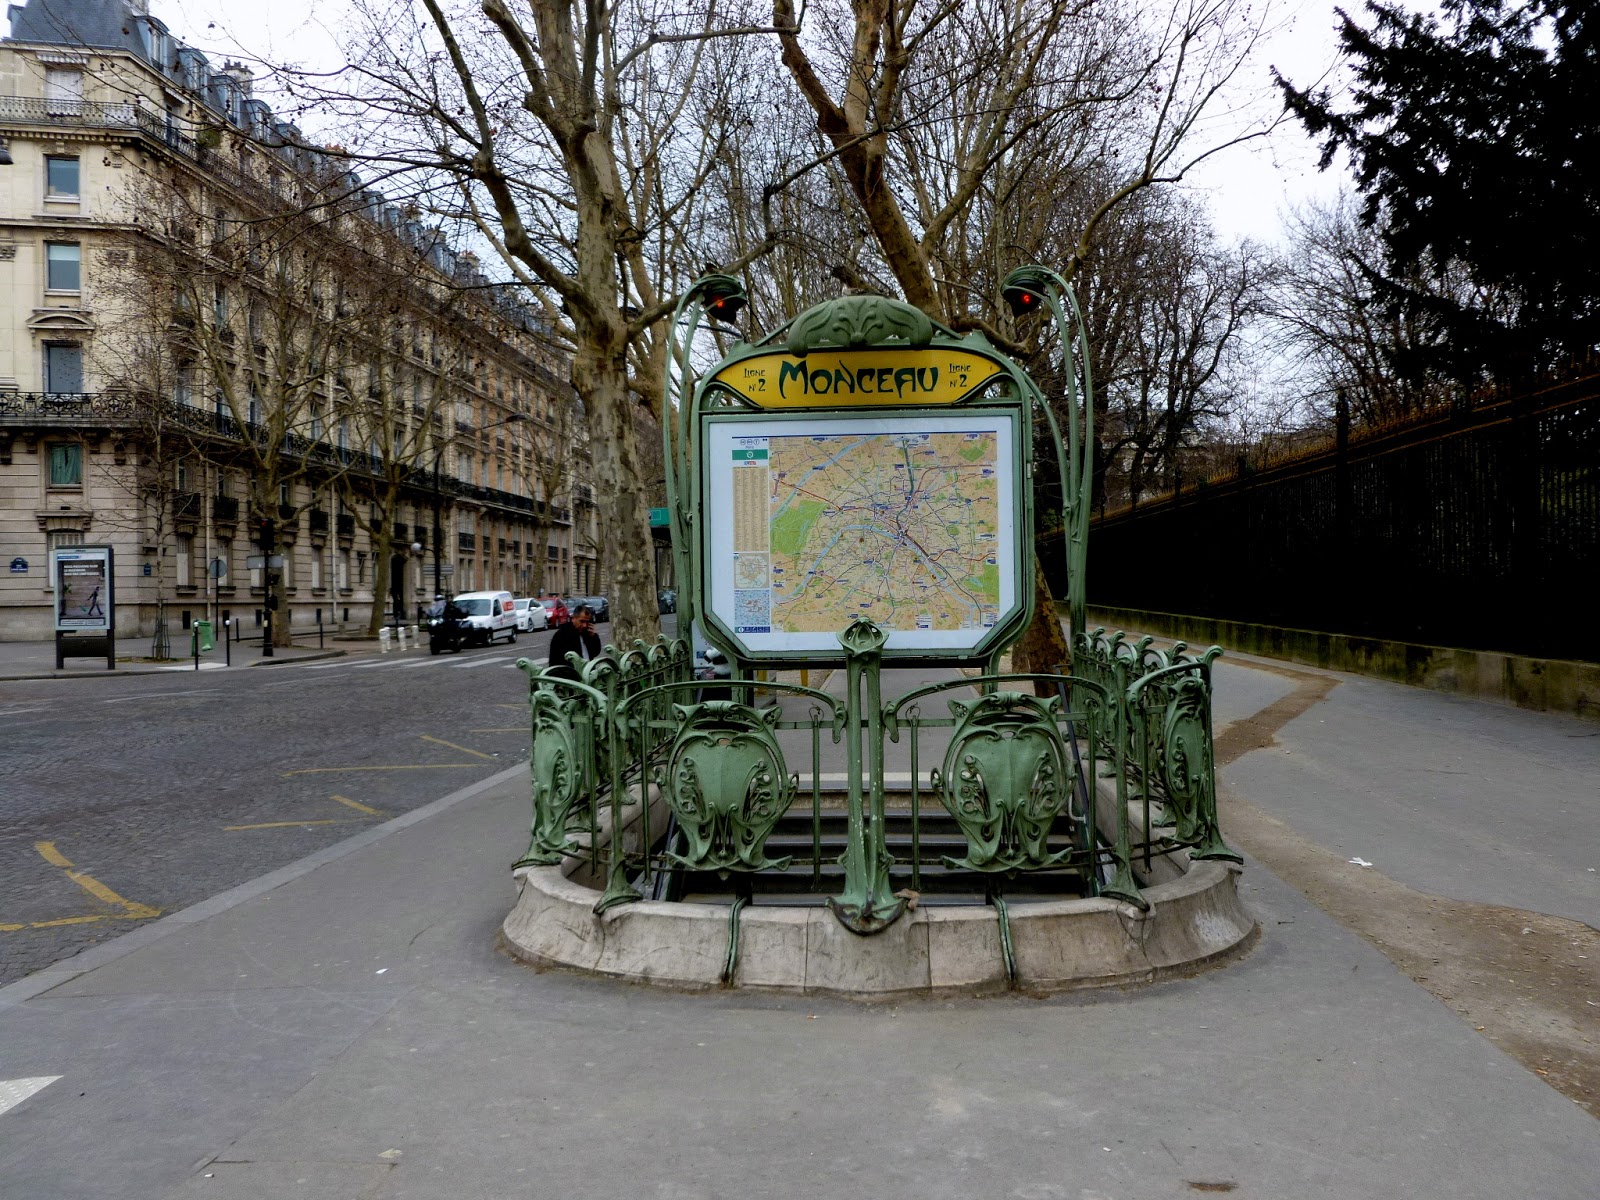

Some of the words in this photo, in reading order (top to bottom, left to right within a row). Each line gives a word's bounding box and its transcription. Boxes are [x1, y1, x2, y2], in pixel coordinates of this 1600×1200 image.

[744, 368, 766, 378] LIGNE
[949, 363, 971, 374] LIGNE
[758, 378, 766, 392] 2
[778, 360, 939, 399] MONCEAU
[959, 373, 967, 388] 2
